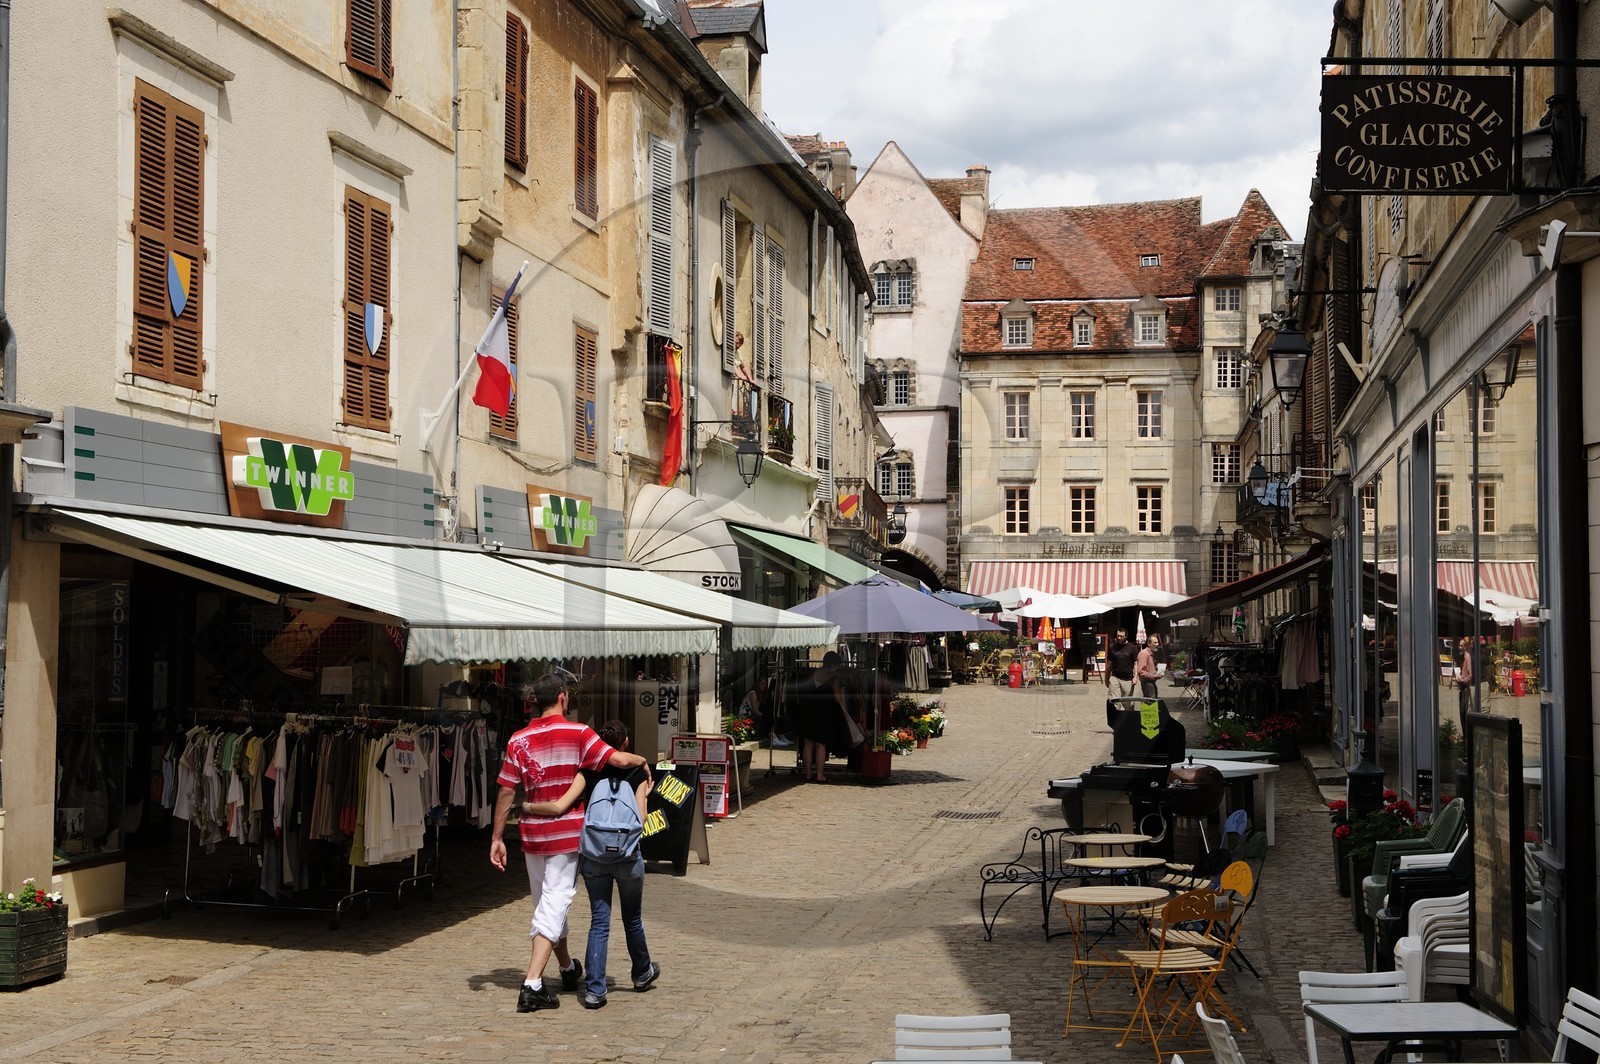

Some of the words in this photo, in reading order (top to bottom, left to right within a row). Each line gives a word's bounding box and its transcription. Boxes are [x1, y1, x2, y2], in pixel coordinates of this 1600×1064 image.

[1331, 81, 1504, 136] PATISSERIE
[1360, 123, 1471, 146] GLACES
[1334, 144, 1502, 190] CONFISERIE
[251, 463, 349, 494] TWINNER
[545, 512, 594, 531] TWINNER
[702, 575, 739, 587] STOCK
[111, 589, 125, 694] SOLDES
[657, 774, 691, 805] SOLDES
[640, 809, 666, 838] OLDES
